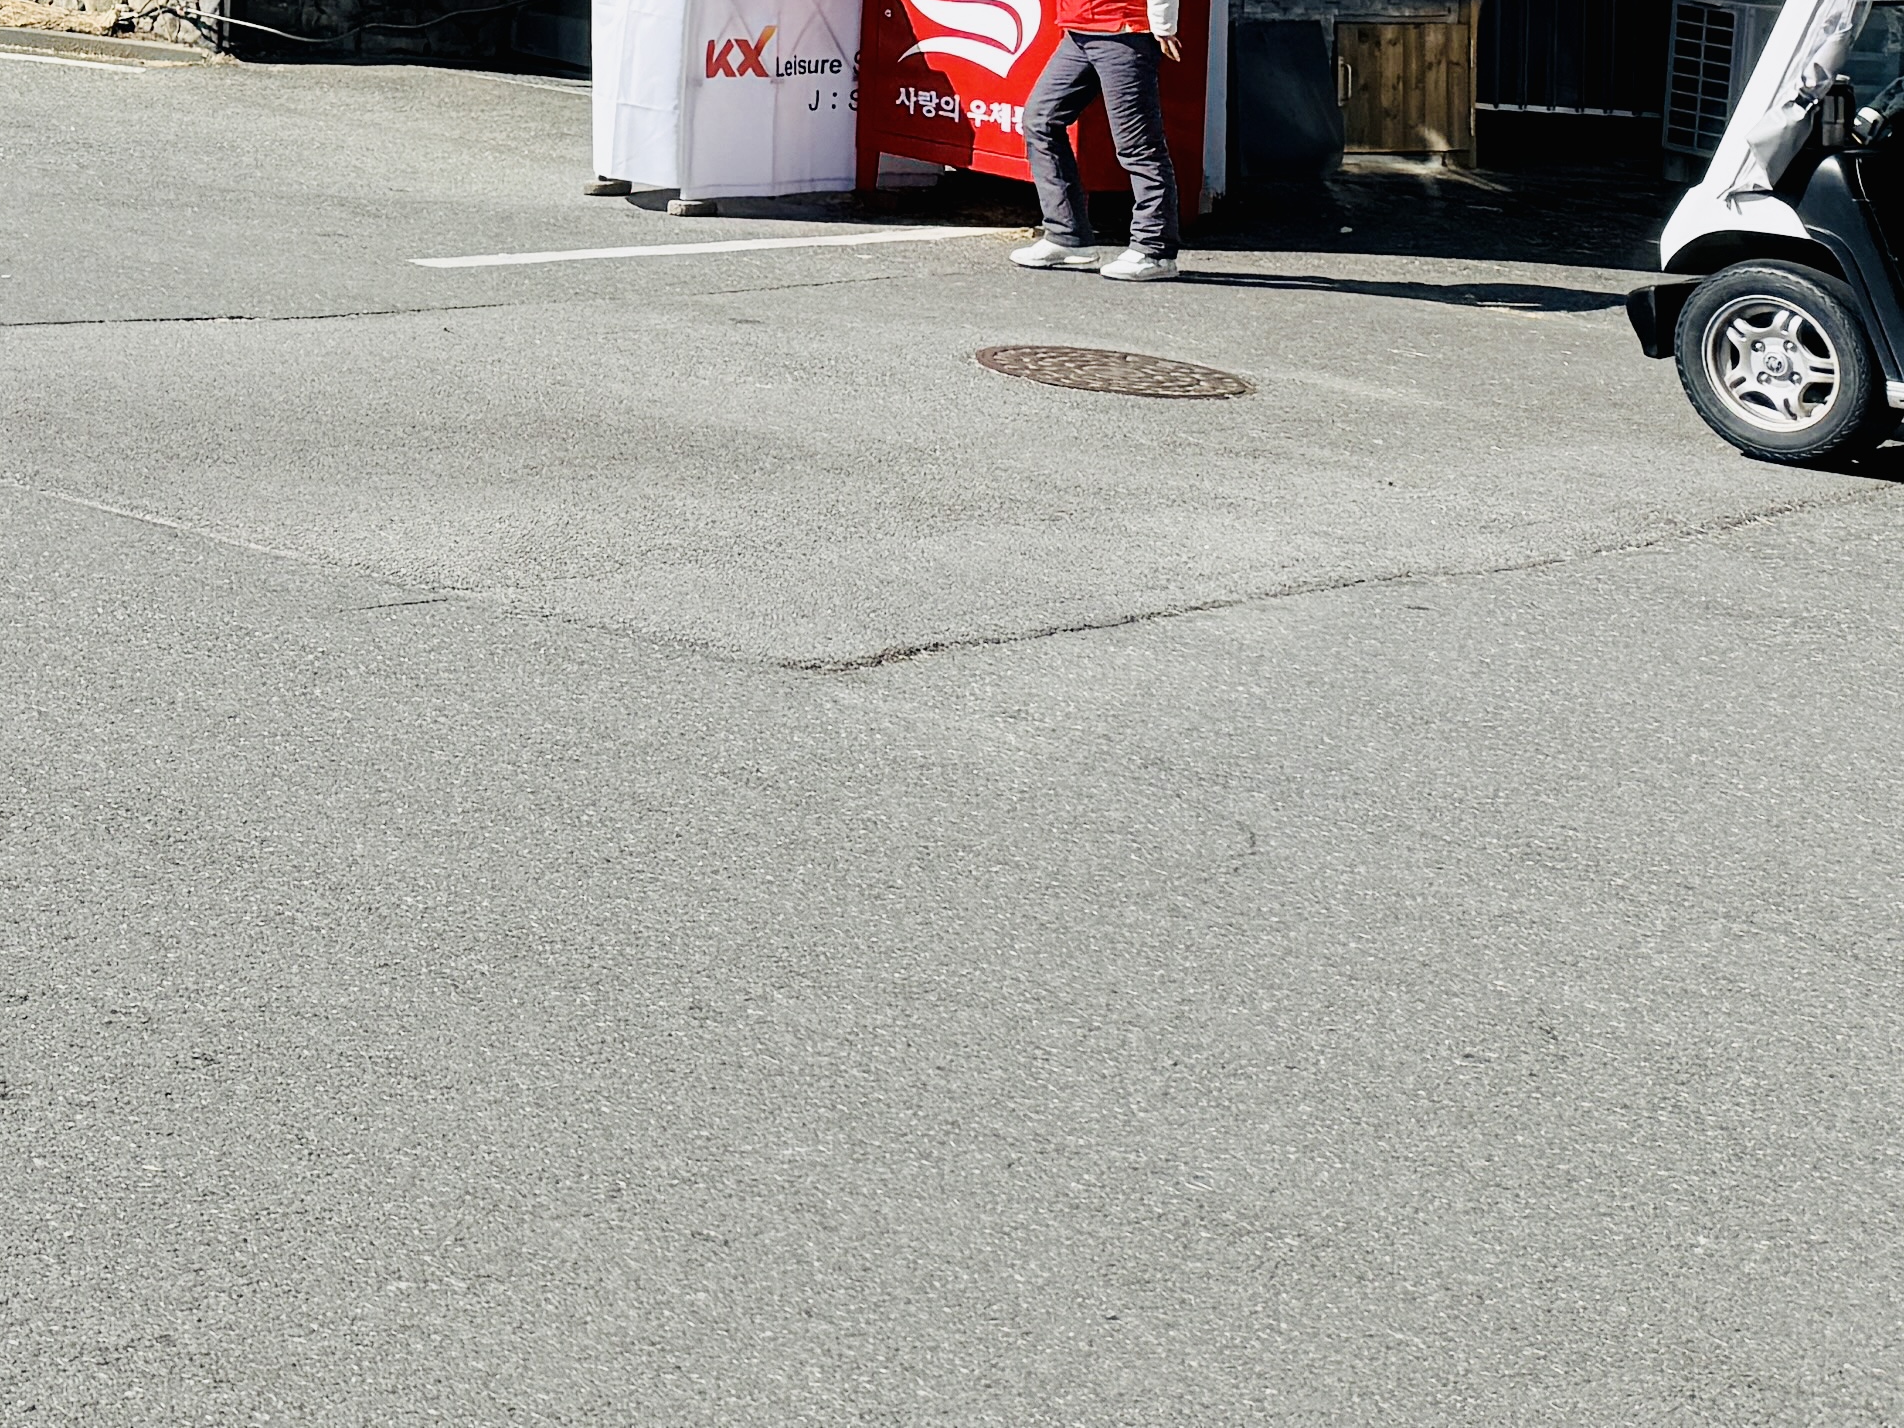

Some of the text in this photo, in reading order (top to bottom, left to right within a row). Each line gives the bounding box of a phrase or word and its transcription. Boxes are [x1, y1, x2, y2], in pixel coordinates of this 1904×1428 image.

[705, 25, 778, 79] KX
[776, 55, 842, 78] Leisure
[895, 87, 960, 123] 사랑의
